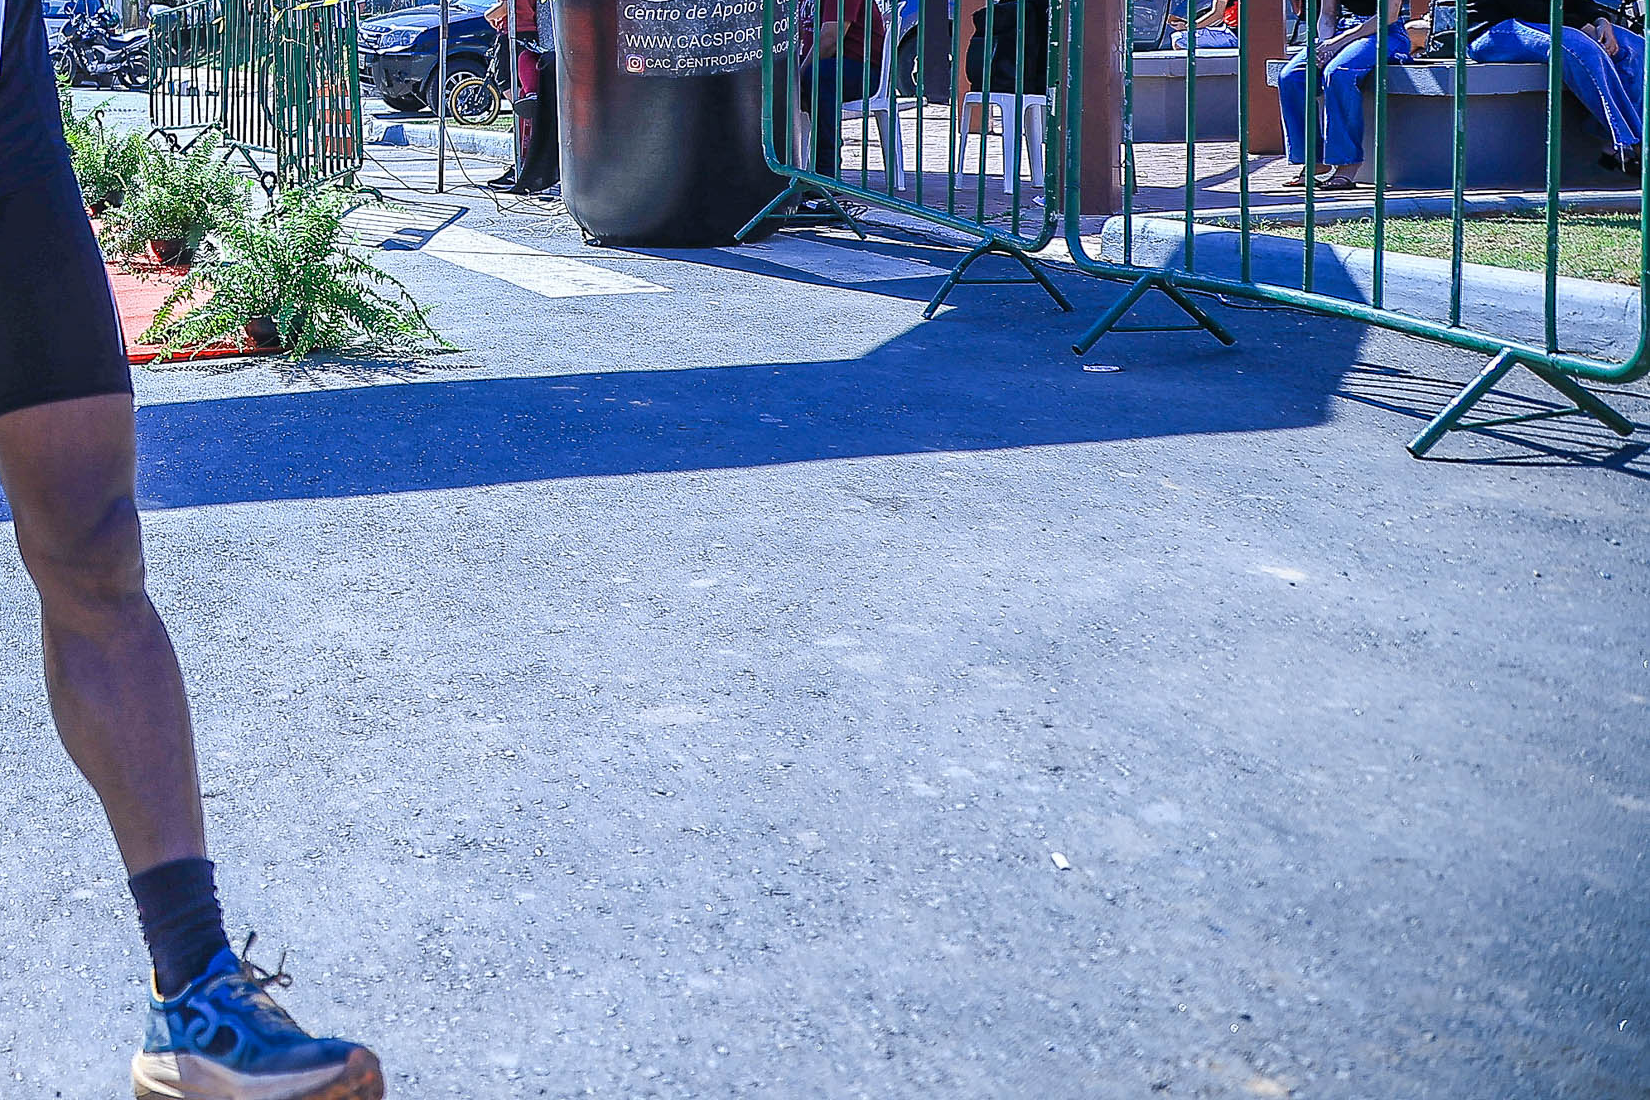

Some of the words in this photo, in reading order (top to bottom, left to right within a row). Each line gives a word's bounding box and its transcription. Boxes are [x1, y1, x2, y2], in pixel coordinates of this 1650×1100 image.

[624, 4, 680, 21] Centro
[686, 5, 707, 20] de
[711, 0, 756, 20] Apoio
